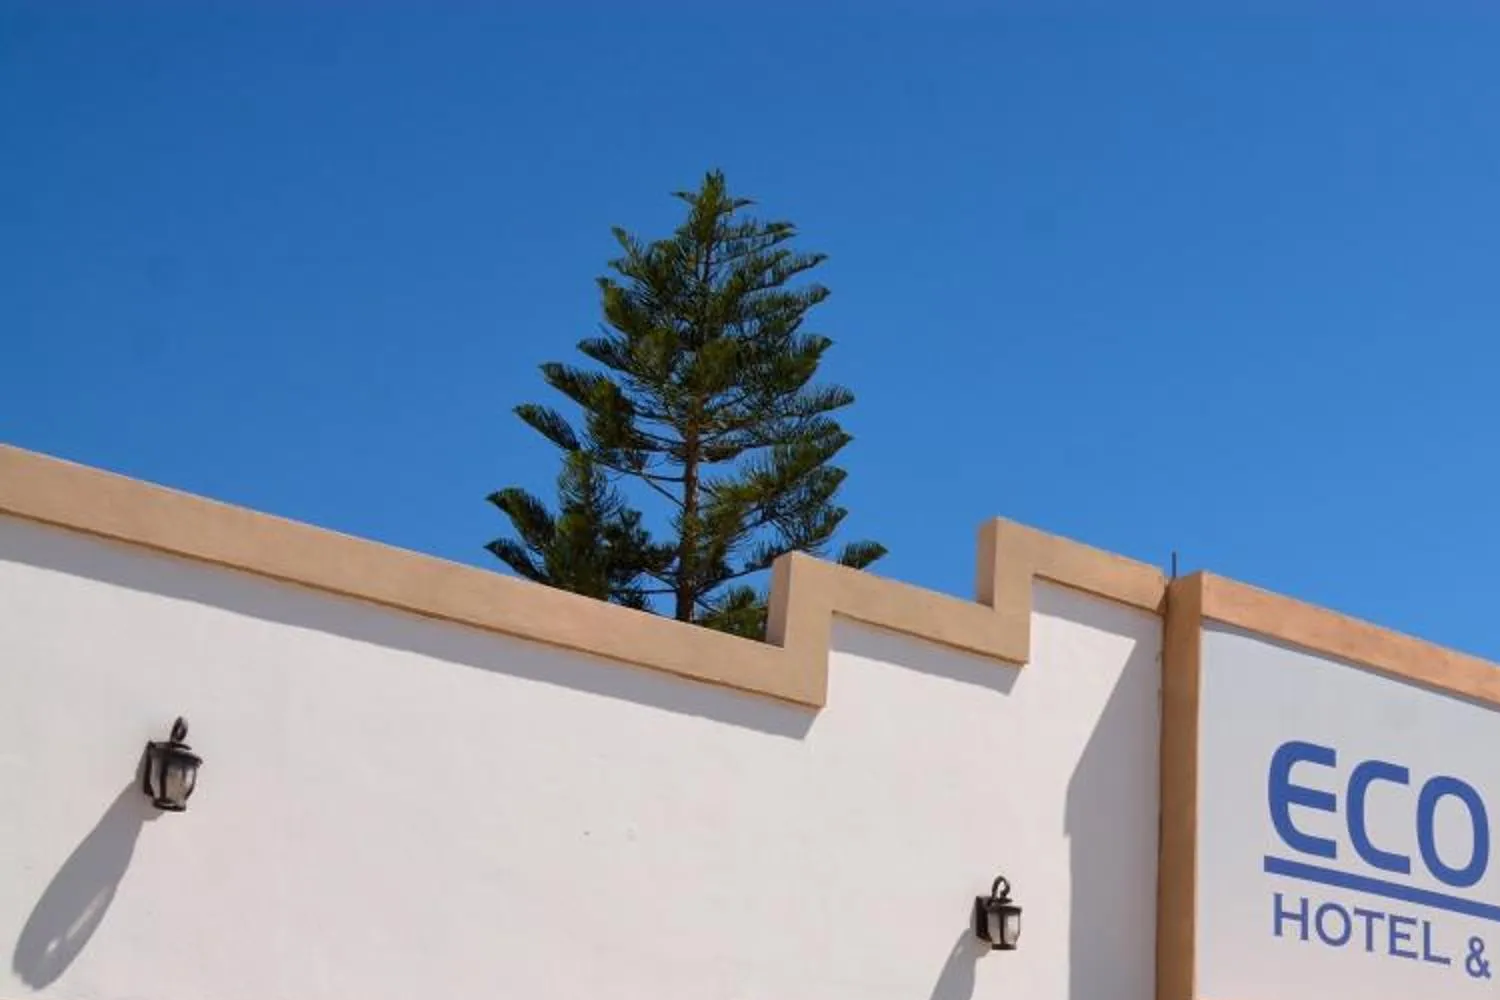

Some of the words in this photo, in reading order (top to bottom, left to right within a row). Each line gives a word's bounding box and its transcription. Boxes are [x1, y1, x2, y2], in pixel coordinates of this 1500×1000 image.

[1268, 740, 1490, 888] ECO
[1273, 893, 1451, 966] HOTEL
[1465, 936, 1492, 979] &
